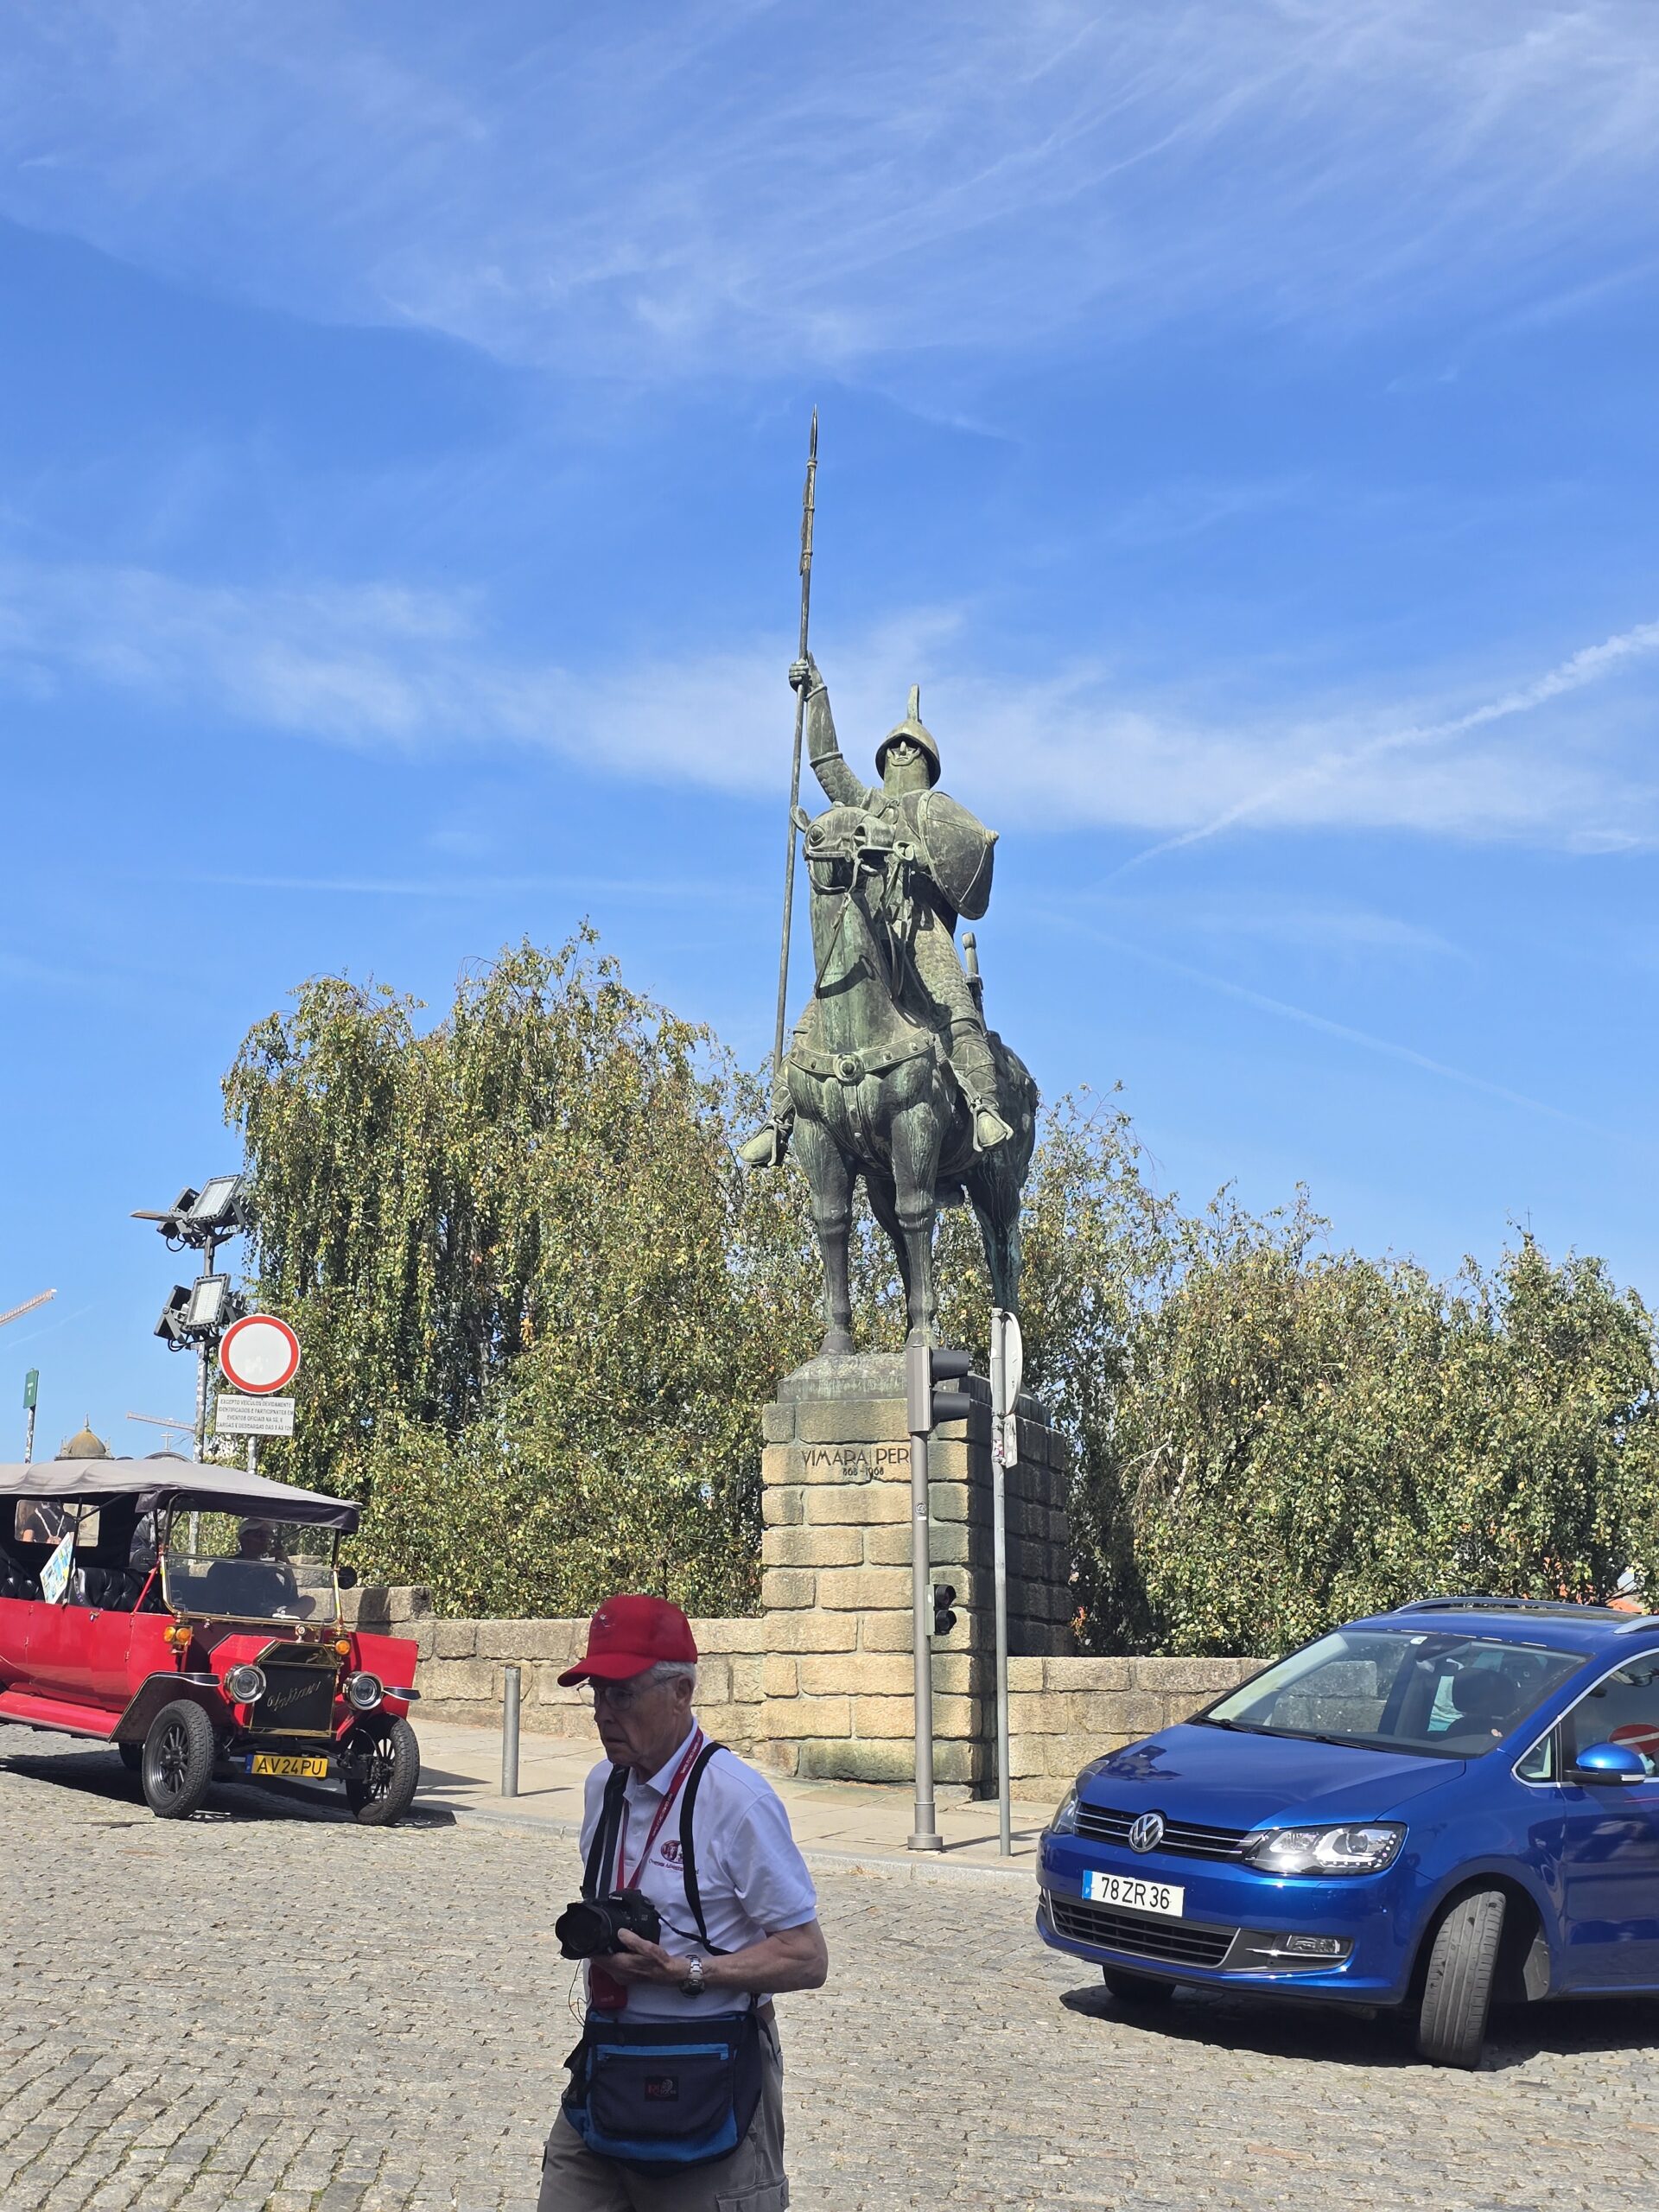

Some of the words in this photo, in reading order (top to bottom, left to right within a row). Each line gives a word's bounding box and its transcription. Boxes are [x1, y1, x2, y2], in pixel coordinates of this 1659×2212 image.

[800, 1448, 868, 1466] VIMARA
[876, 1447, 911, 1465] PER
[257, 1758, 322, 1775] AV24PU
